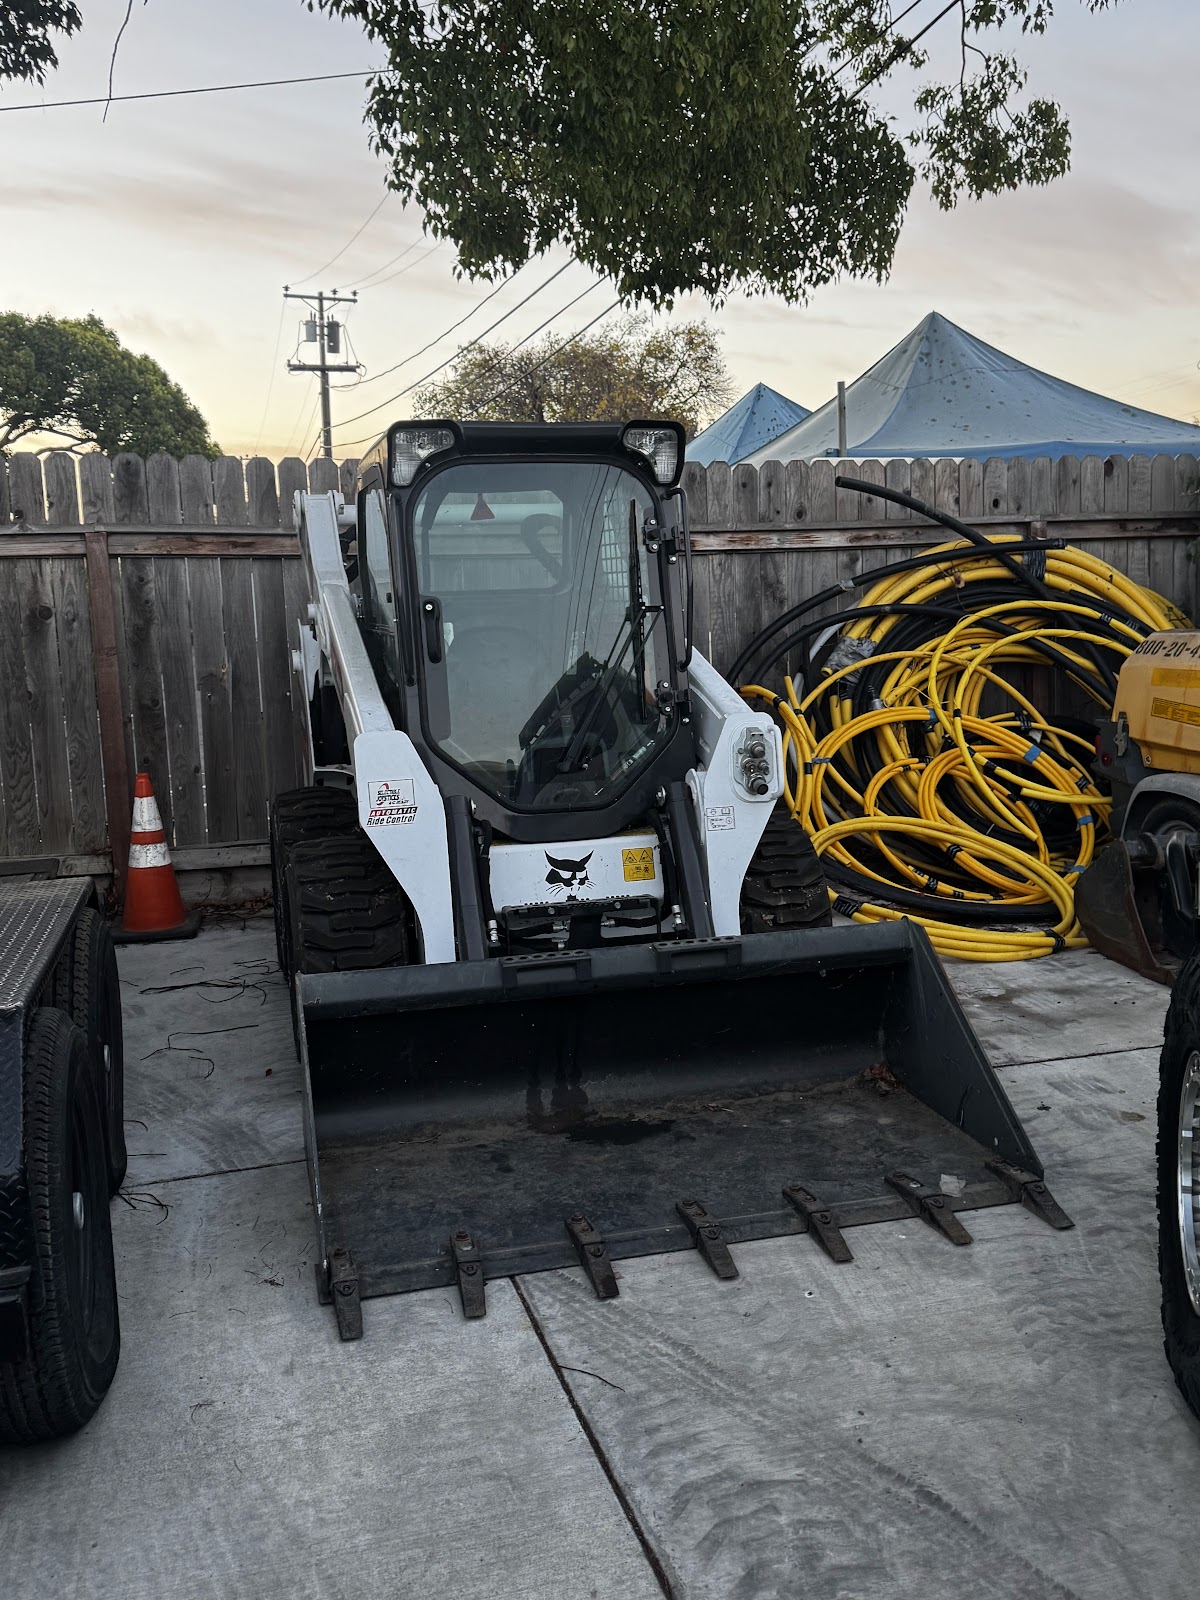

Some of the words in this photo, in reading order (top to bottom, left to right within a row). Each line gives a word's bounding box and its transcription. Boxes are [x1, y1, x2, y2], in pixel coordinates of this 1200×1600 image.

[1135, 640, 1200, 658] 800-20-4
[370, 807, 417, 816] AUTOMATIC
[366, 817, 385, 826] Ride
[385, 814, 416, 824] Control
